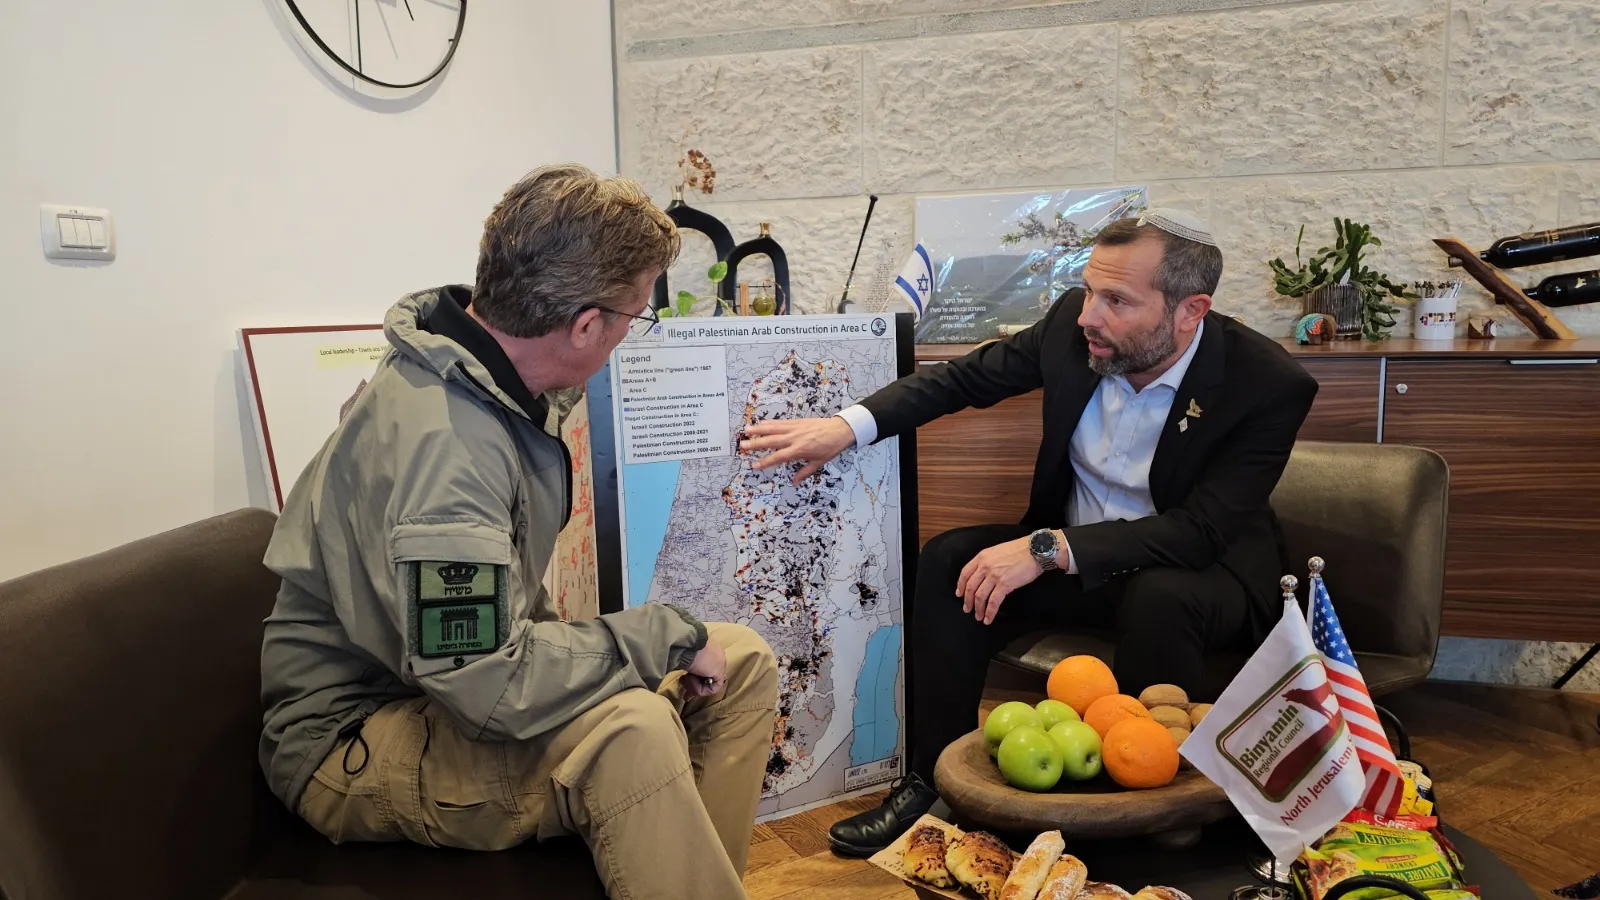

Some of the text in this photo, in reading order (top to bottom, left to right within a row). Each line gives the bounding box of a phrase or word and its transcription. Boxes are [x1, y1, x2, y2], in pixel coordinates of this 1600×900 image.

[668, 328, 696, 340] Illegal
[698, 327, 748, 337] Palestinian
[752, 326, 772, 336] Arab
[774, 325, 828, 334] Construction
[830, 324, 838, 332] in
[840, 324, 860, 332] Area
[861, 324, 868, 332] C
[621, 355, 651, 364] Legend
[444, 586, 472, 596] משיח
[1240, 704, 1299, 768] Binyamin
[1253, 718, 1304, 778] Regional Council
[1280, 746, 1352, 826] North Jerusalem
[1408, 862, 1444, 882] NATURE
